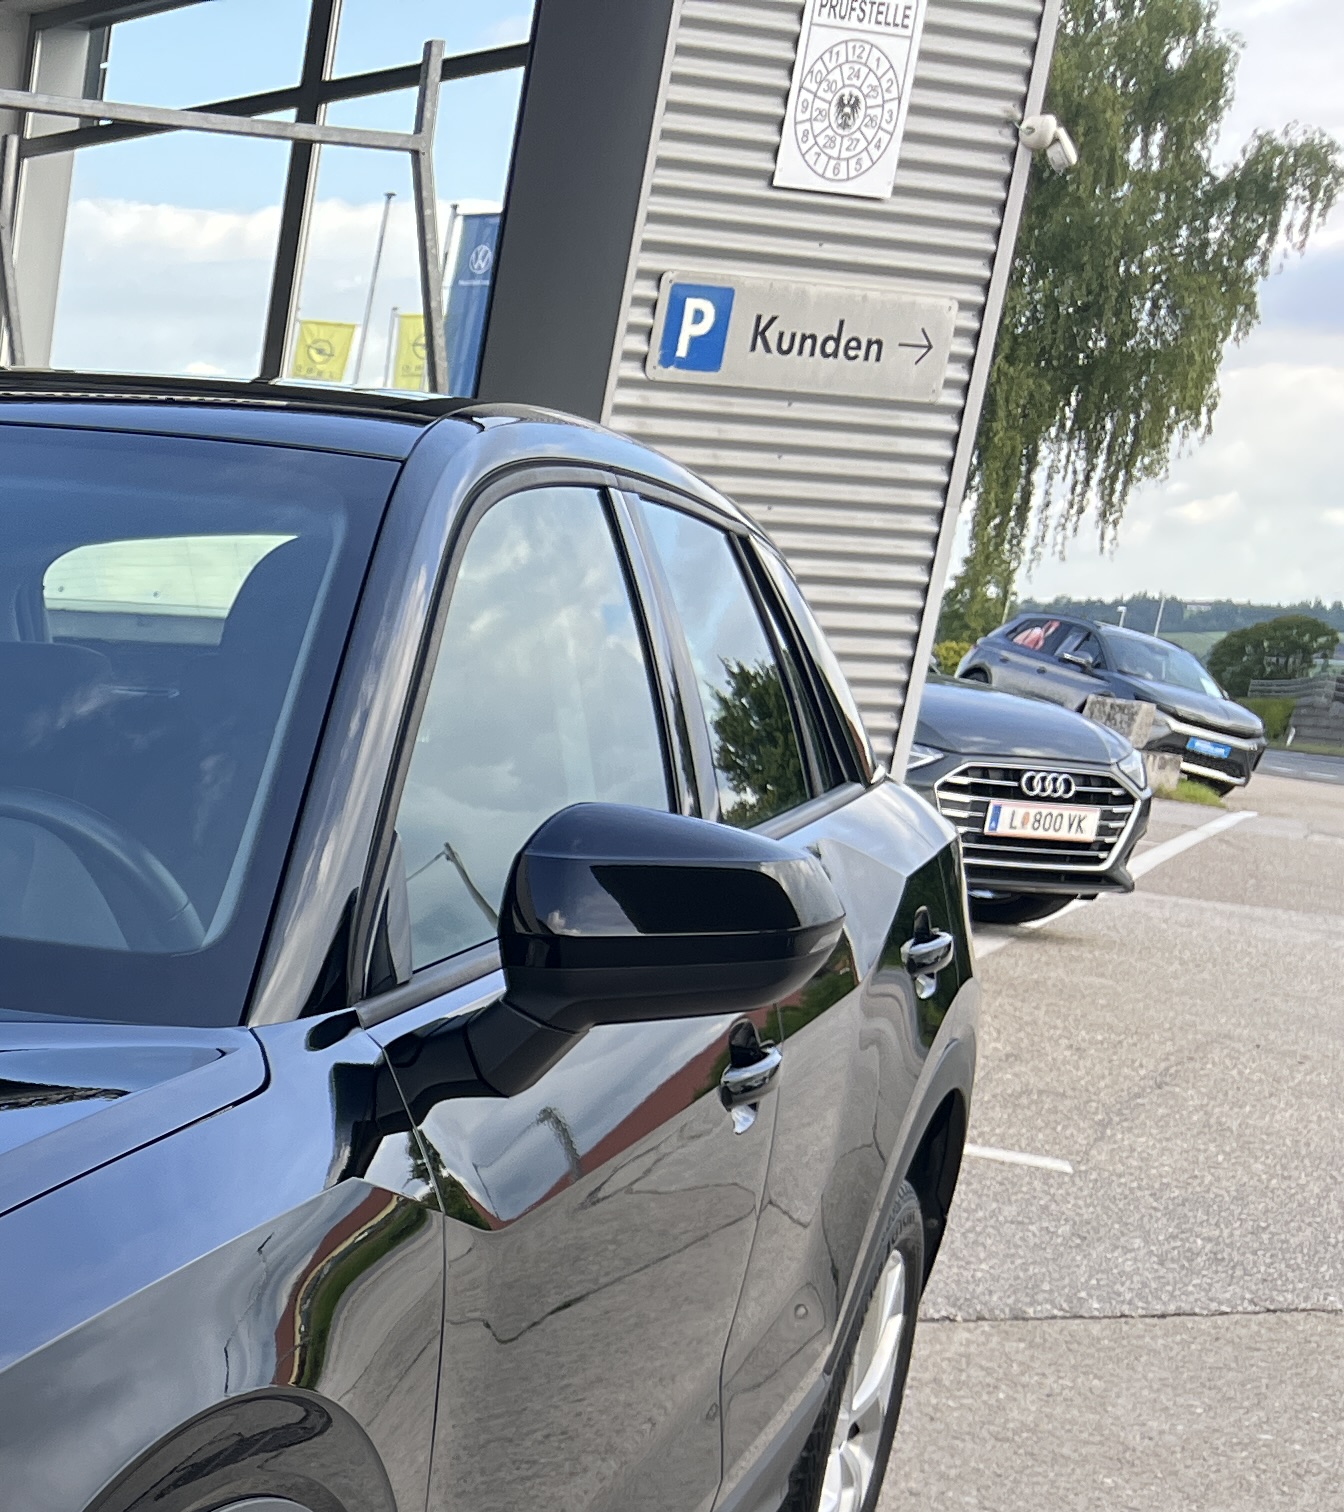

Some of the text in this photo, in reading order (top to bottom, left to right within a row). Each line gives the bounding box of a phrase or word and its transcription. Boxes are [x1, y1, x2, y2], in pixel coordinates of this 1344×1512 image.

[828, 49, 840, 65] 11
[851, 44, 866, 60] 12
[809, 69, 823, 84] 10
[847, 66, 861, 81] 24
[822, 78, 838, 94] 30
[865, 83, 880, 99] 25
[884, 78, 894, 94] 2
[800, 98, 810, 114] 9
[812, 107, 828, 123] 29
[864, 113, 878, 129] 26
[884, 109, 894, 125] 3
[800, 128, 810, 144] 8
[822, 134, 838, 150] 28
[873, 136, 882, 152] 4
[845, 137, 861, 152] 27
[813, 151, 822, 167] 7
[854, 157, 863, 172] 5
[832, 162, 841, 177] 6
[675, 297, 885, 363] P Kunden
[1009, 810, 1088, 835] L 800 VK
